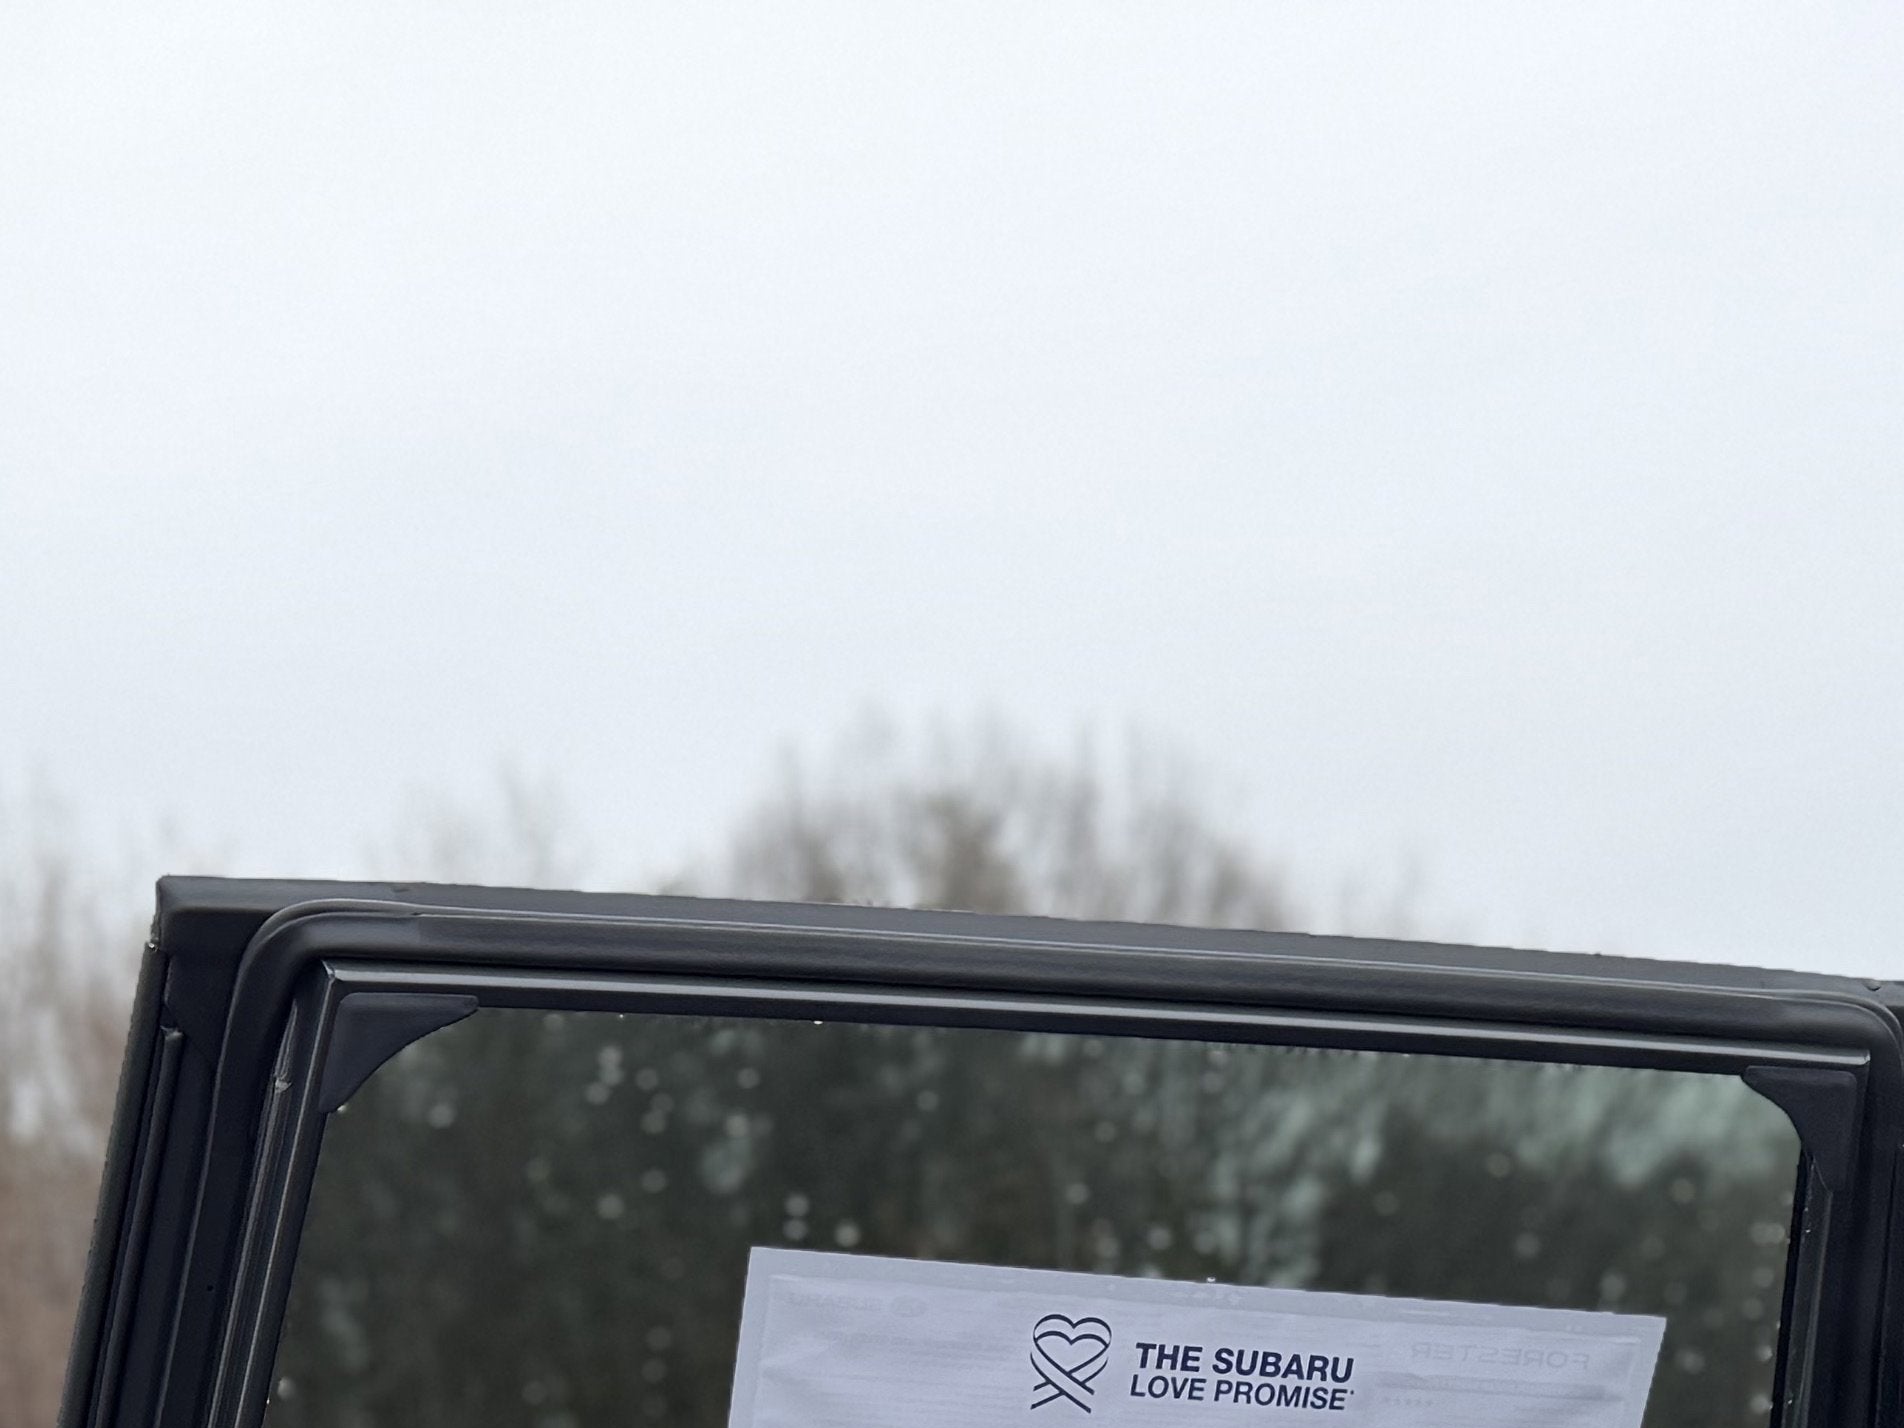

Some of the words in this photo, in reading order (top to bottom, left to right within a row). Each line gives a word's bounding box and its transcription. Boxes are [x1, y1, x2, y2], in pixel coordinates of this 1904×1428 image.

[1135, 1342, 1203, 1372] THE
[1212, 1348, 1354, 1384] SUBARU
[1130, 1374, 1207, 1401] LOVE
[1214, 1380, 1346, 1411] PROMISE
